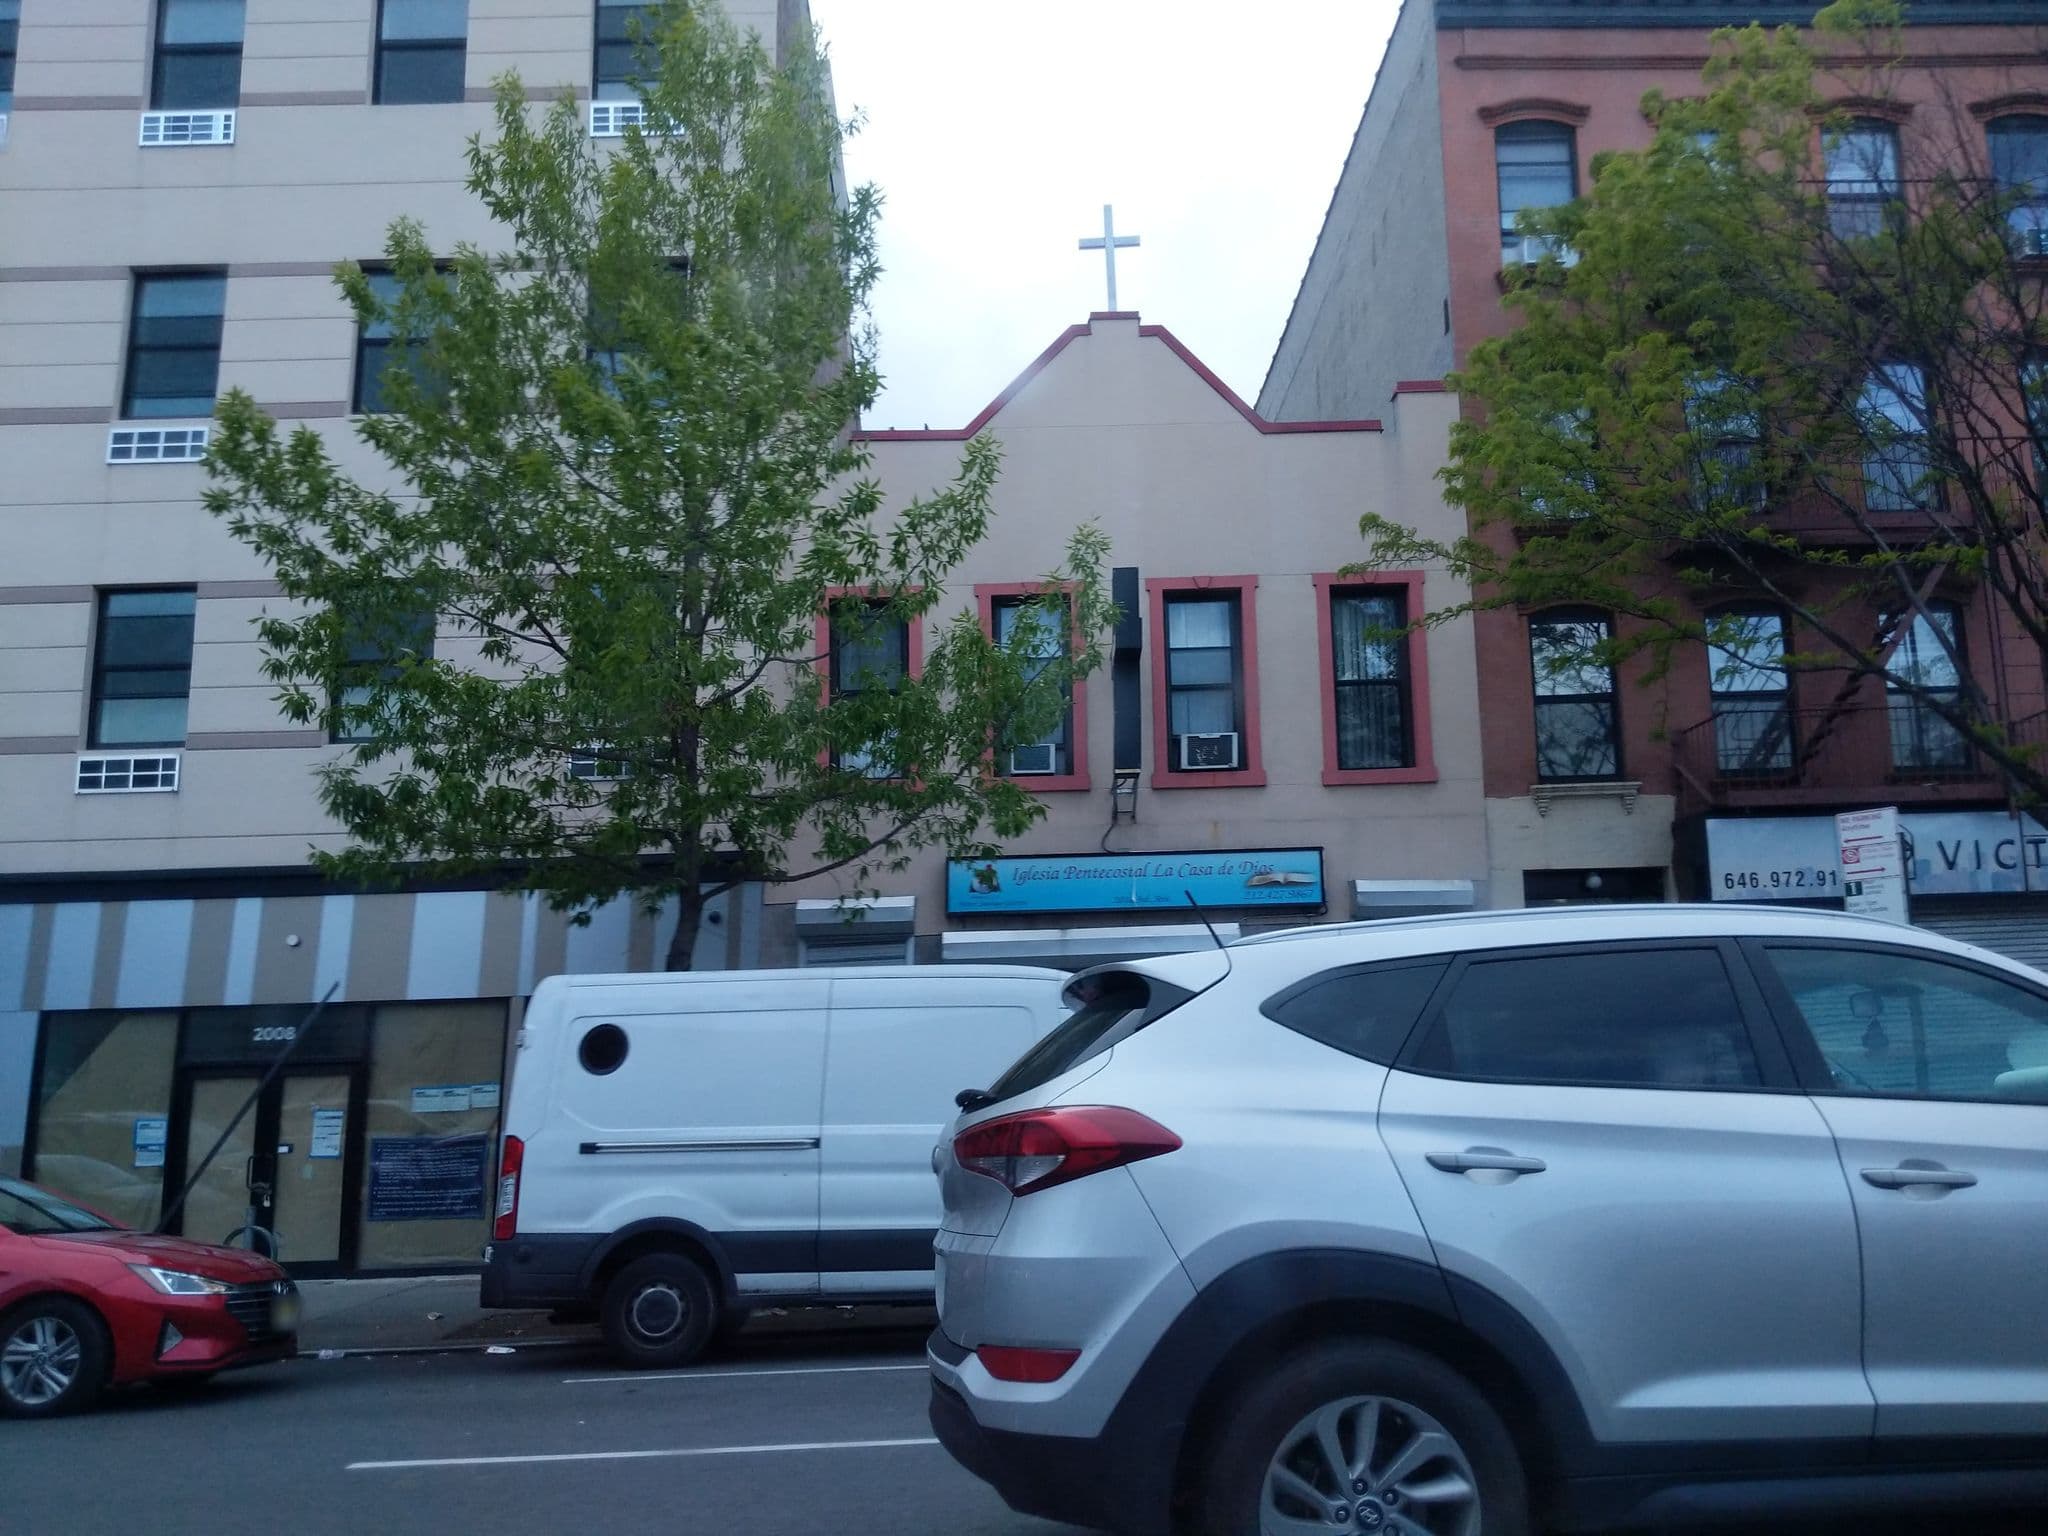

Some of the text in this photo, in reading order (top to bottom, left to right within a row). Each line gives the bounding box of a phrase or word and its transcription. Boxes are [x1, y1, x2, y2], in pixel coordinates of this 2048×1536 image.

[1937, 838, 2047, 871] VICT
[1013, 860, 1274, 886] Iglesia Pentecostal La Casa de Dios
[1724, 870, 1837, 889] 646.972.91
[253, 1026, 297, 1041] 2008
